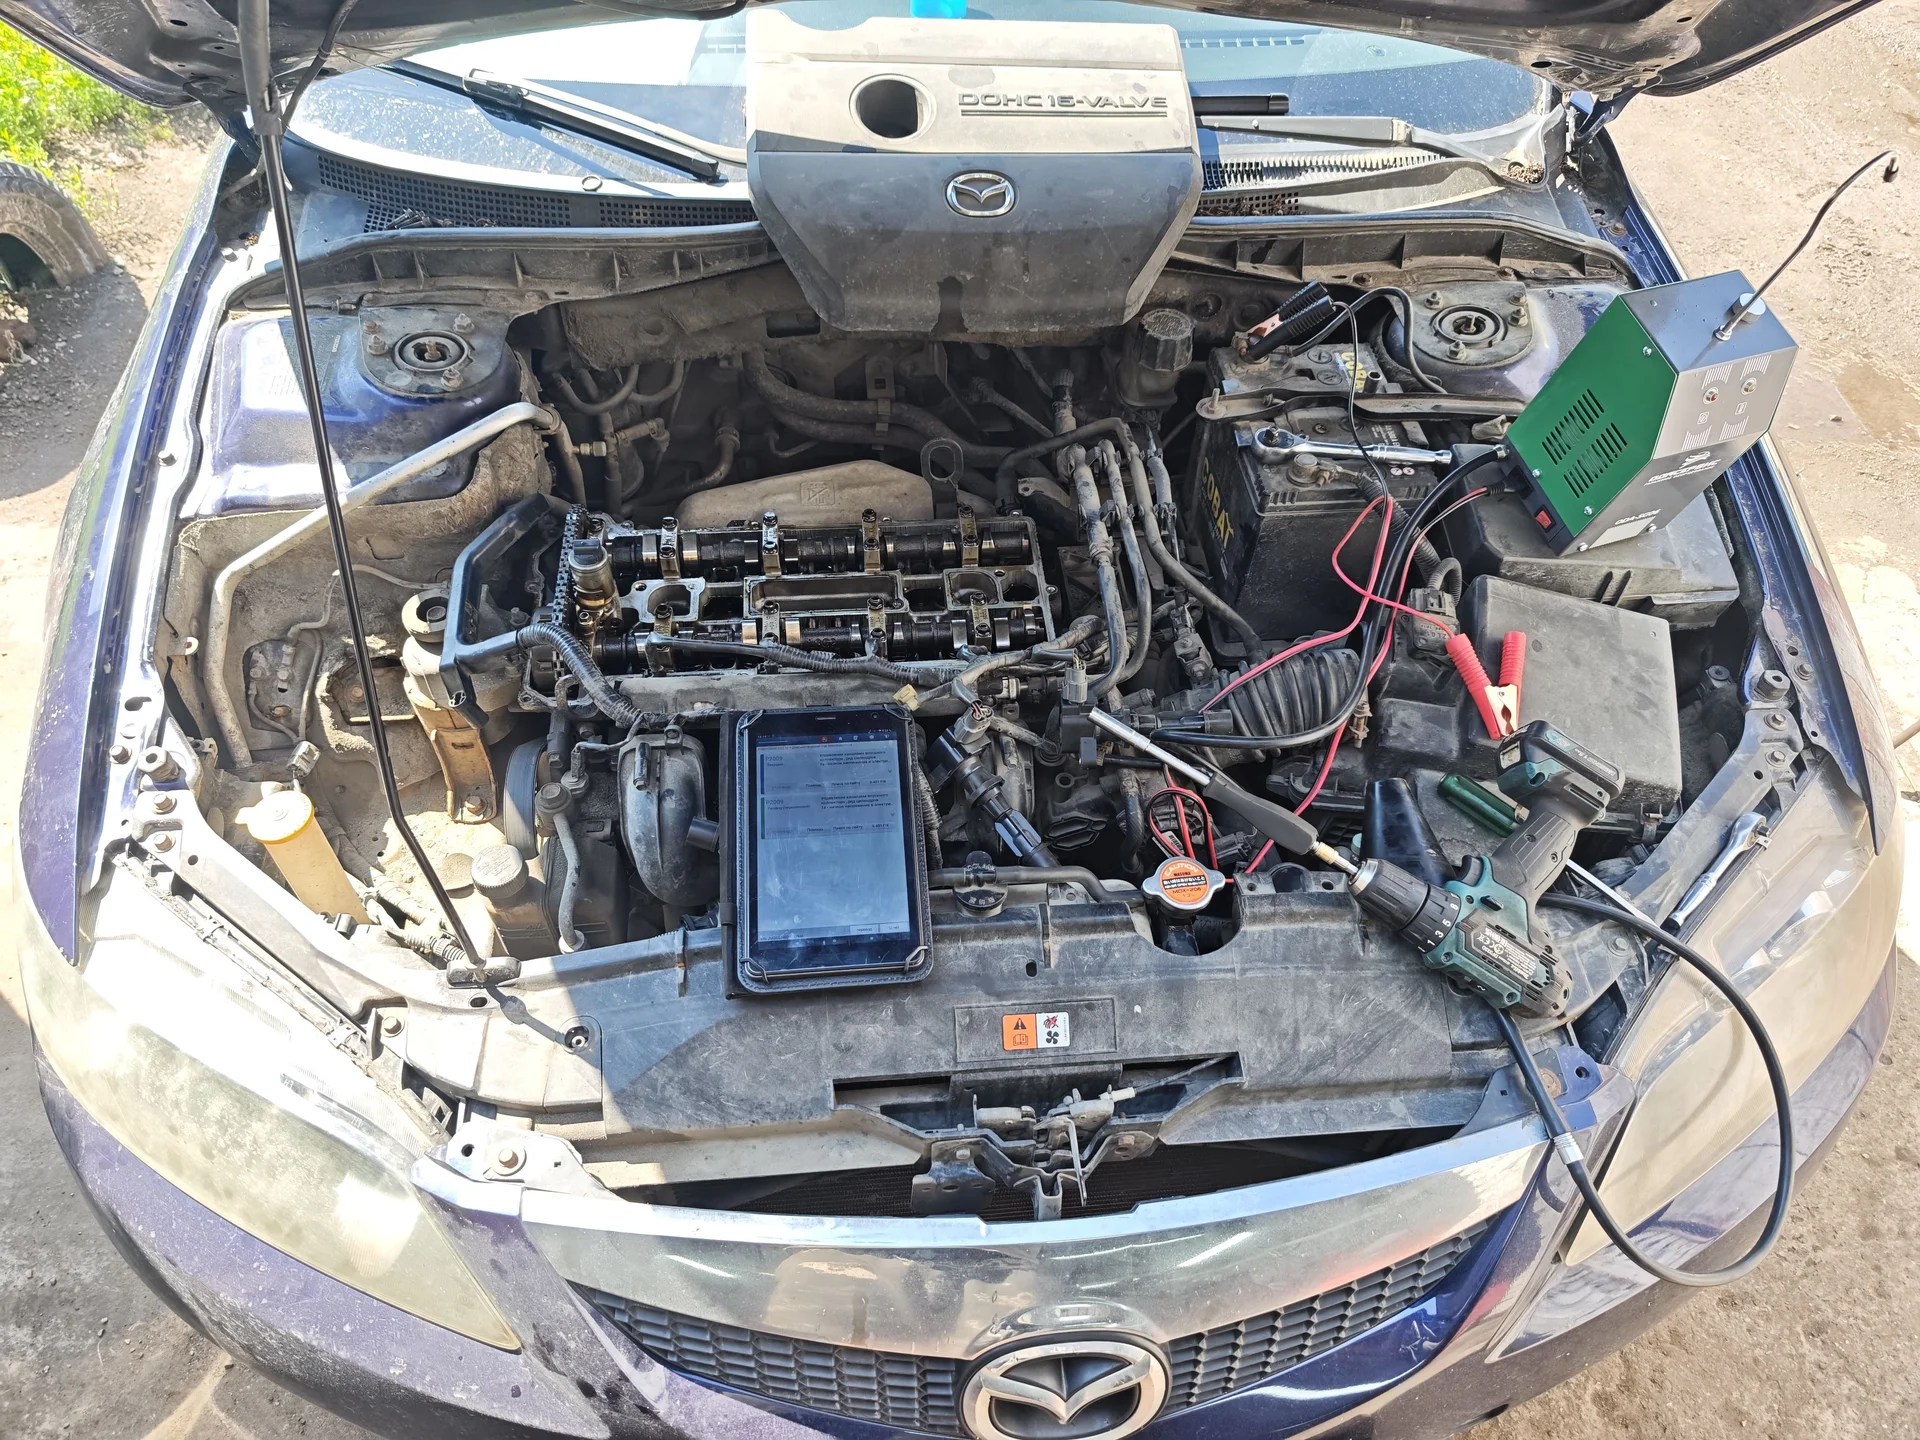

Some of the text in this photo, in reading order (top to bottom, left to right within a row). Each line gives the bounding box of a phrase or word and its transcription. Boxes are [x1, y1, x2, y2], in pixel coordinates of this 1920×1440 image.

[958, 93, 1168, 108] DOHC 16-VALVE
[1341, 352, 1368, 393] COBA
[1202, 457, 1234, 549] COBAT
[1165, 863, 1198, 876] CAUTION
[1434, 930, 1444, 938] 3
[1442, 918, 1452, 927] 5
